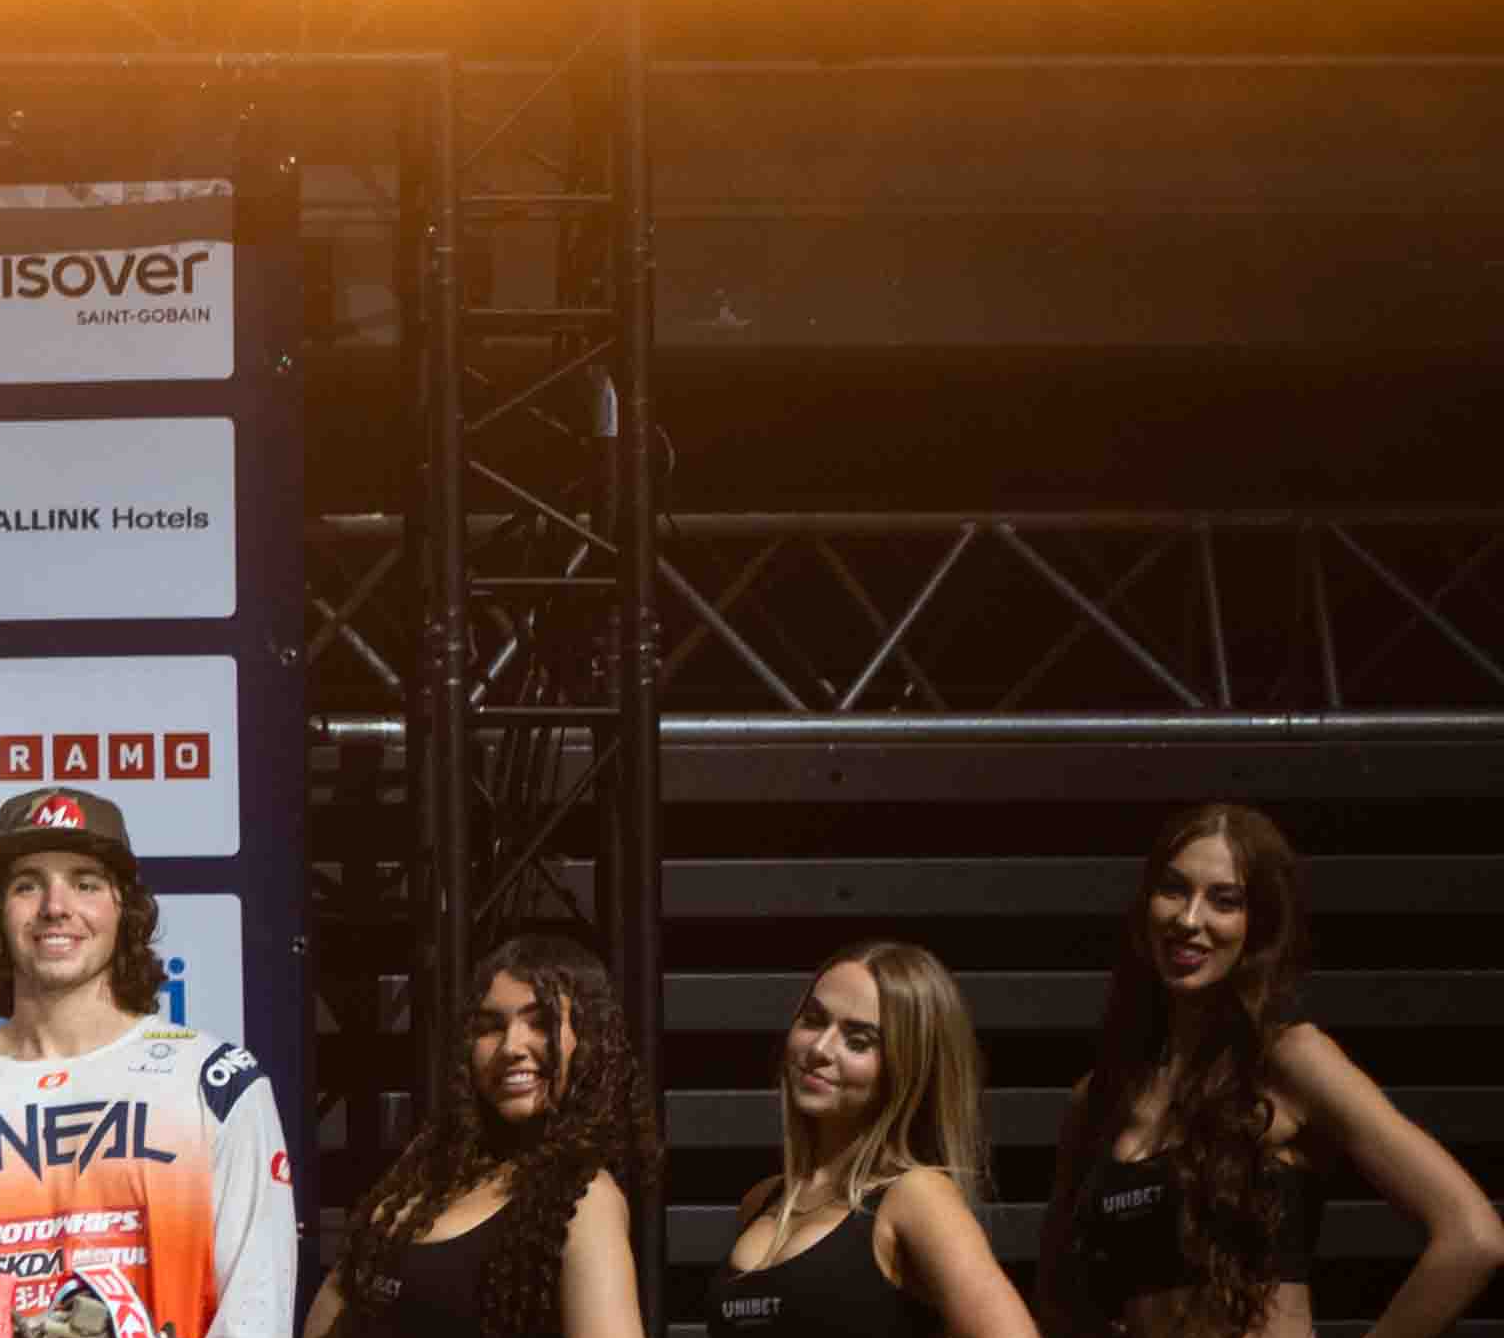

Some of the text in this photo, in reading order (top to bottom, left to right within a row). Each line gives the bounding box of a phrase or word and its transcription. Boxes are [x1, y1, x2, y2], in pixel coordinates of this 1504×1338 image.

[76, 306, 211, 327] SAINT-GOBAIN
[111, 505, 210, 531] Hotels
[1103, 1183, 1163, 1213] UNIBET
[722, 1295, 782, 1319] UNIBET
